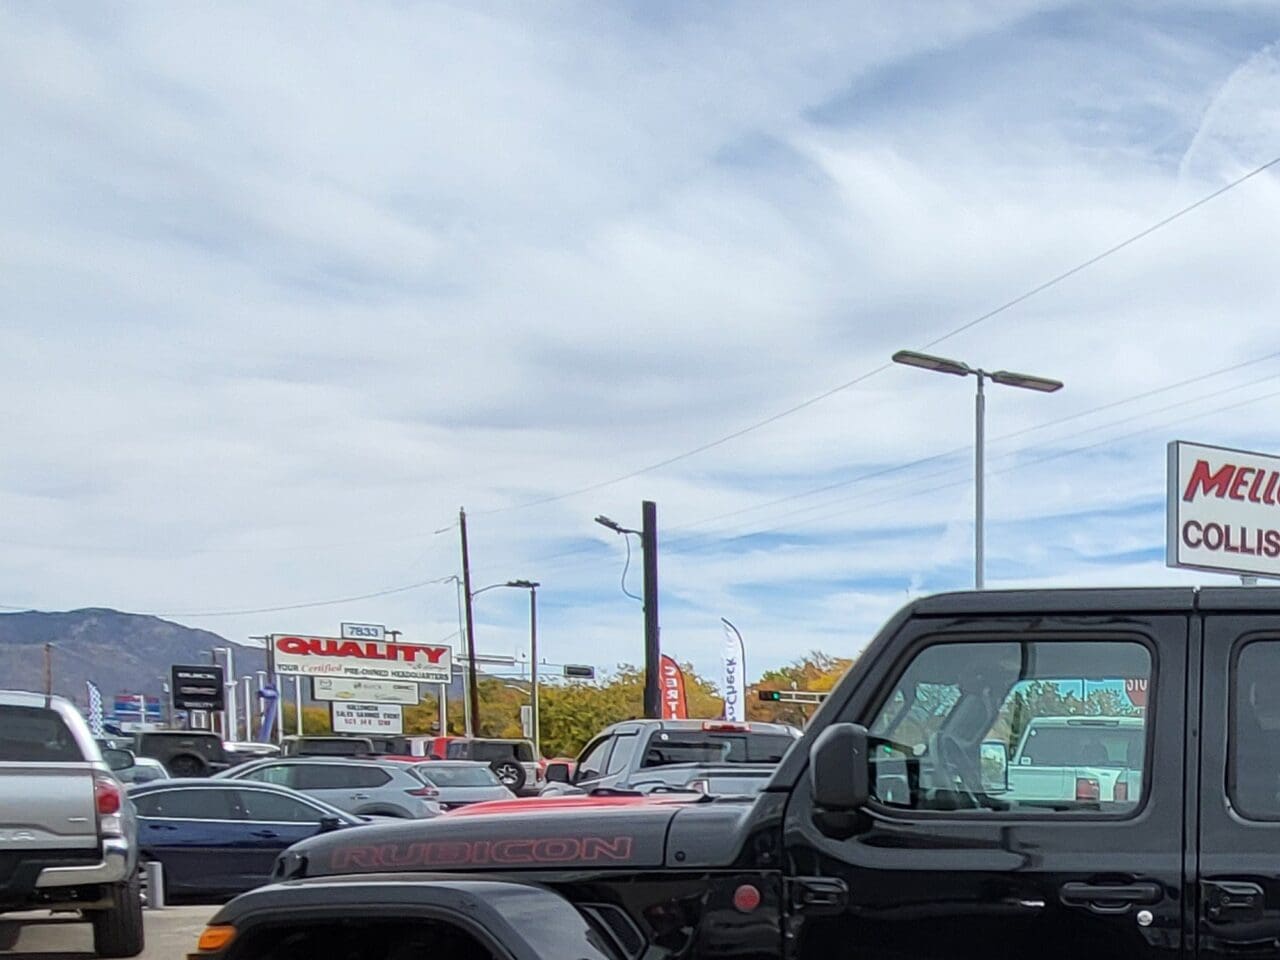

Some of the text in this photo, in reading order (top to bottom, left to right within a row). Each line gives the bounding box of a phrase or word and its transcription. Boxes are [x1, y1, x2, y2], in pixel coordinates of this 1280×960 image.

[348, 626, 378, 637] 7833
[276, 637, 448, 664] QUALITY
[277, 663, 449, 681] YOUR Certified PRE-OWNED HEADQUARTERS
[331, 837, 633, 869] RUBICON
